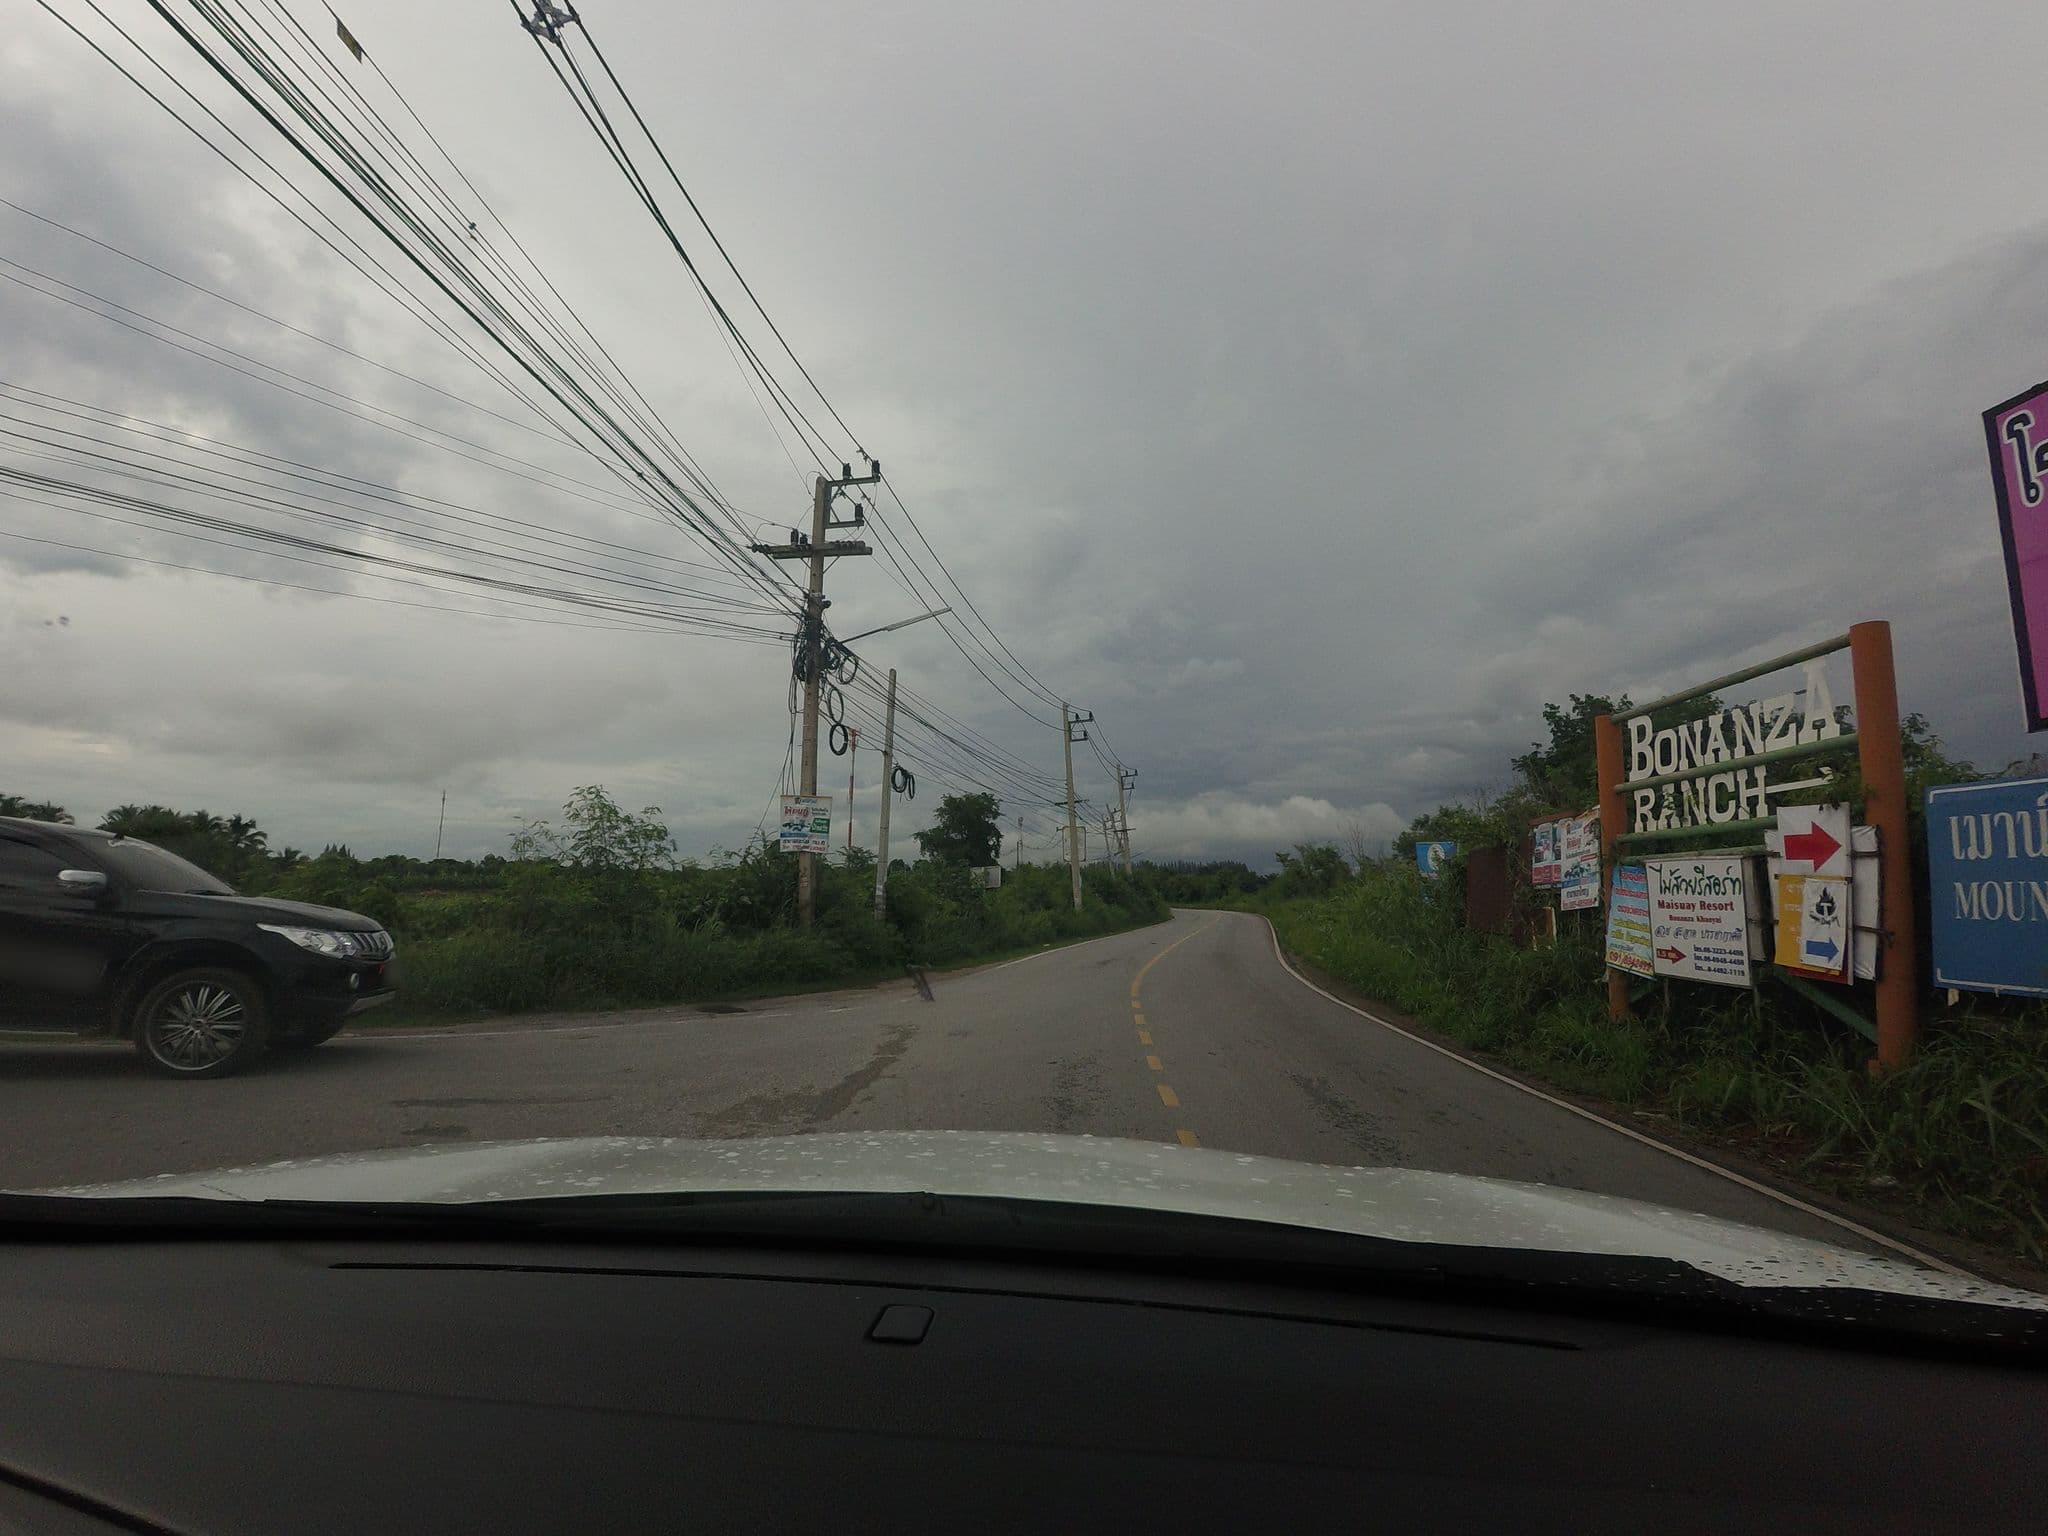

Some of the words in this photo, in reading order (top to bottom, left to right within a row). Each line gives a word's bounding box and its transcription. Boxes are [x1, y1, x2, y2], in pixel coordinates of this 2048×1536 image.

[1628, 656, 1840, 782] BONANZA
[1633, 765, 1768, 833] RANCH
[1657, 899, 1697, 912] Maisuay
[1699, 900, 1735, 912] Resort
[1668, 914, 1694, 923] Bonanza
